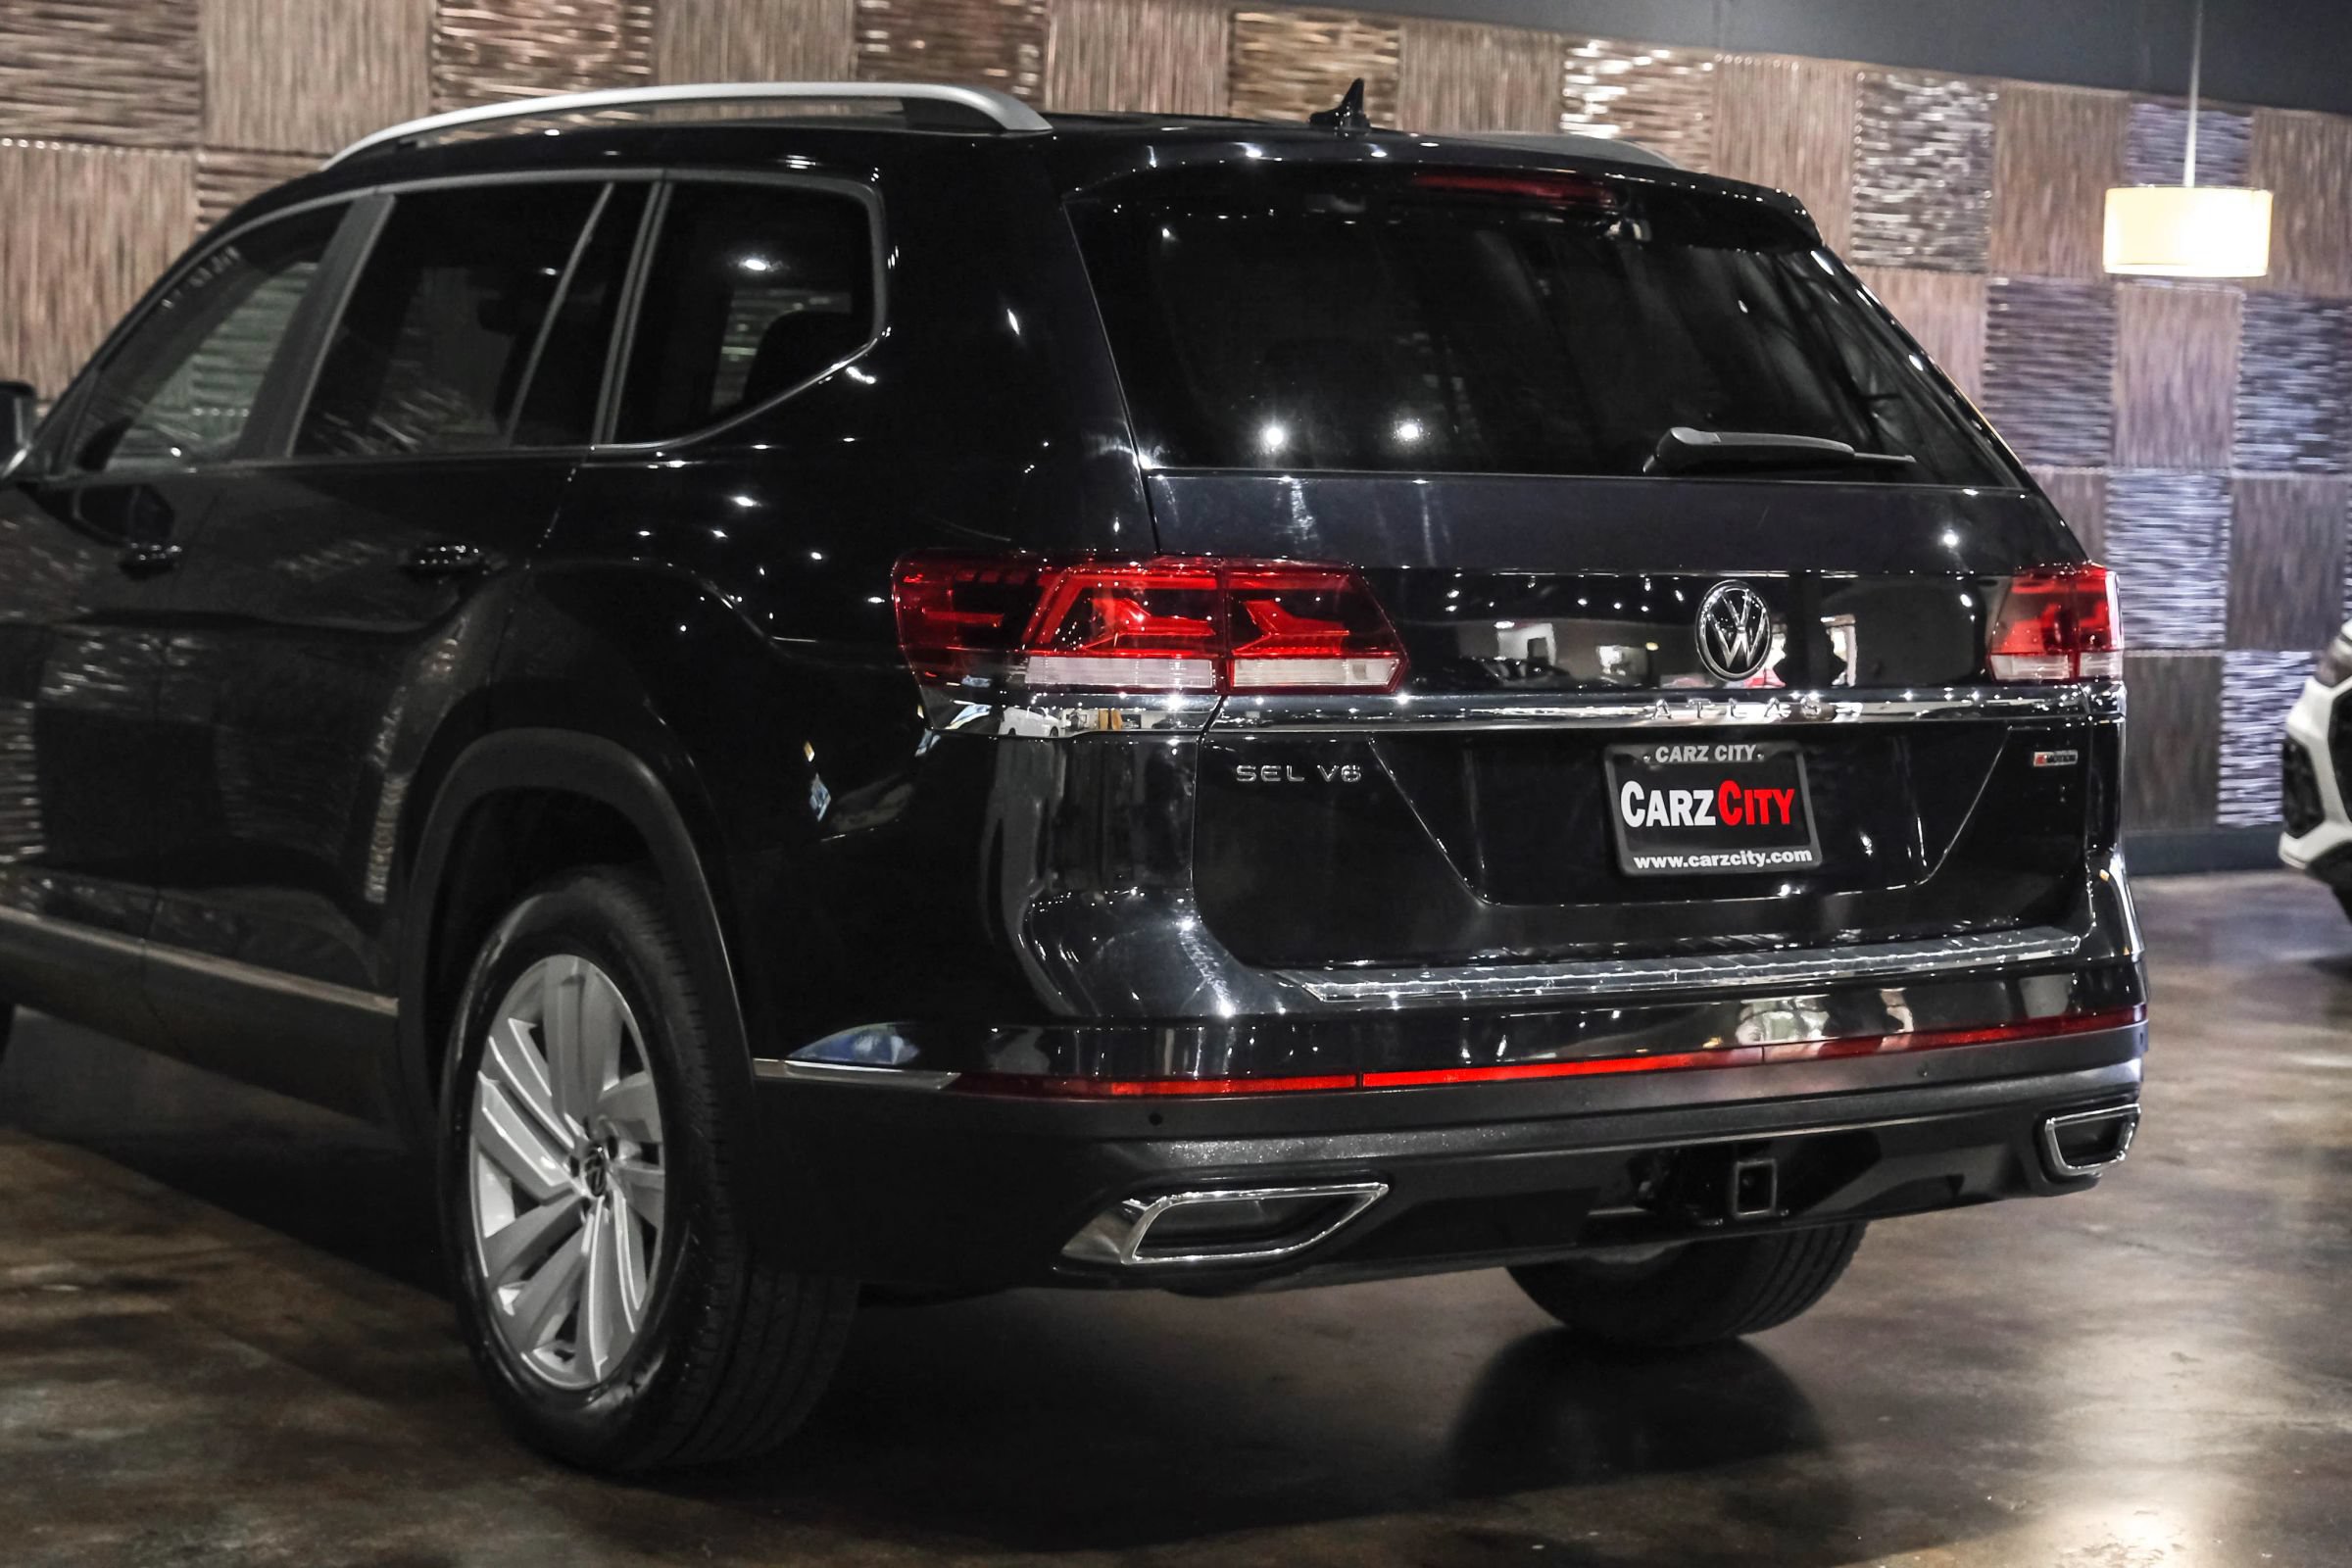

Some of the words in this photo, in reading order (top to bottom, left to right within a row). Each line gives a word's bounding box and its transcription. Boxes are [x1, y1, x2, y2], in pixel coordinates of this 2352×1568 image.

[1655, 746, 1709, 763] CARZ
[1715, 744, 1757, 761] CITY
[1236, 764, 1305, 782] SEL
[1316, 764, 1362, 782] V6
[1634, 849, 1813, 869] www.carzcity.com
